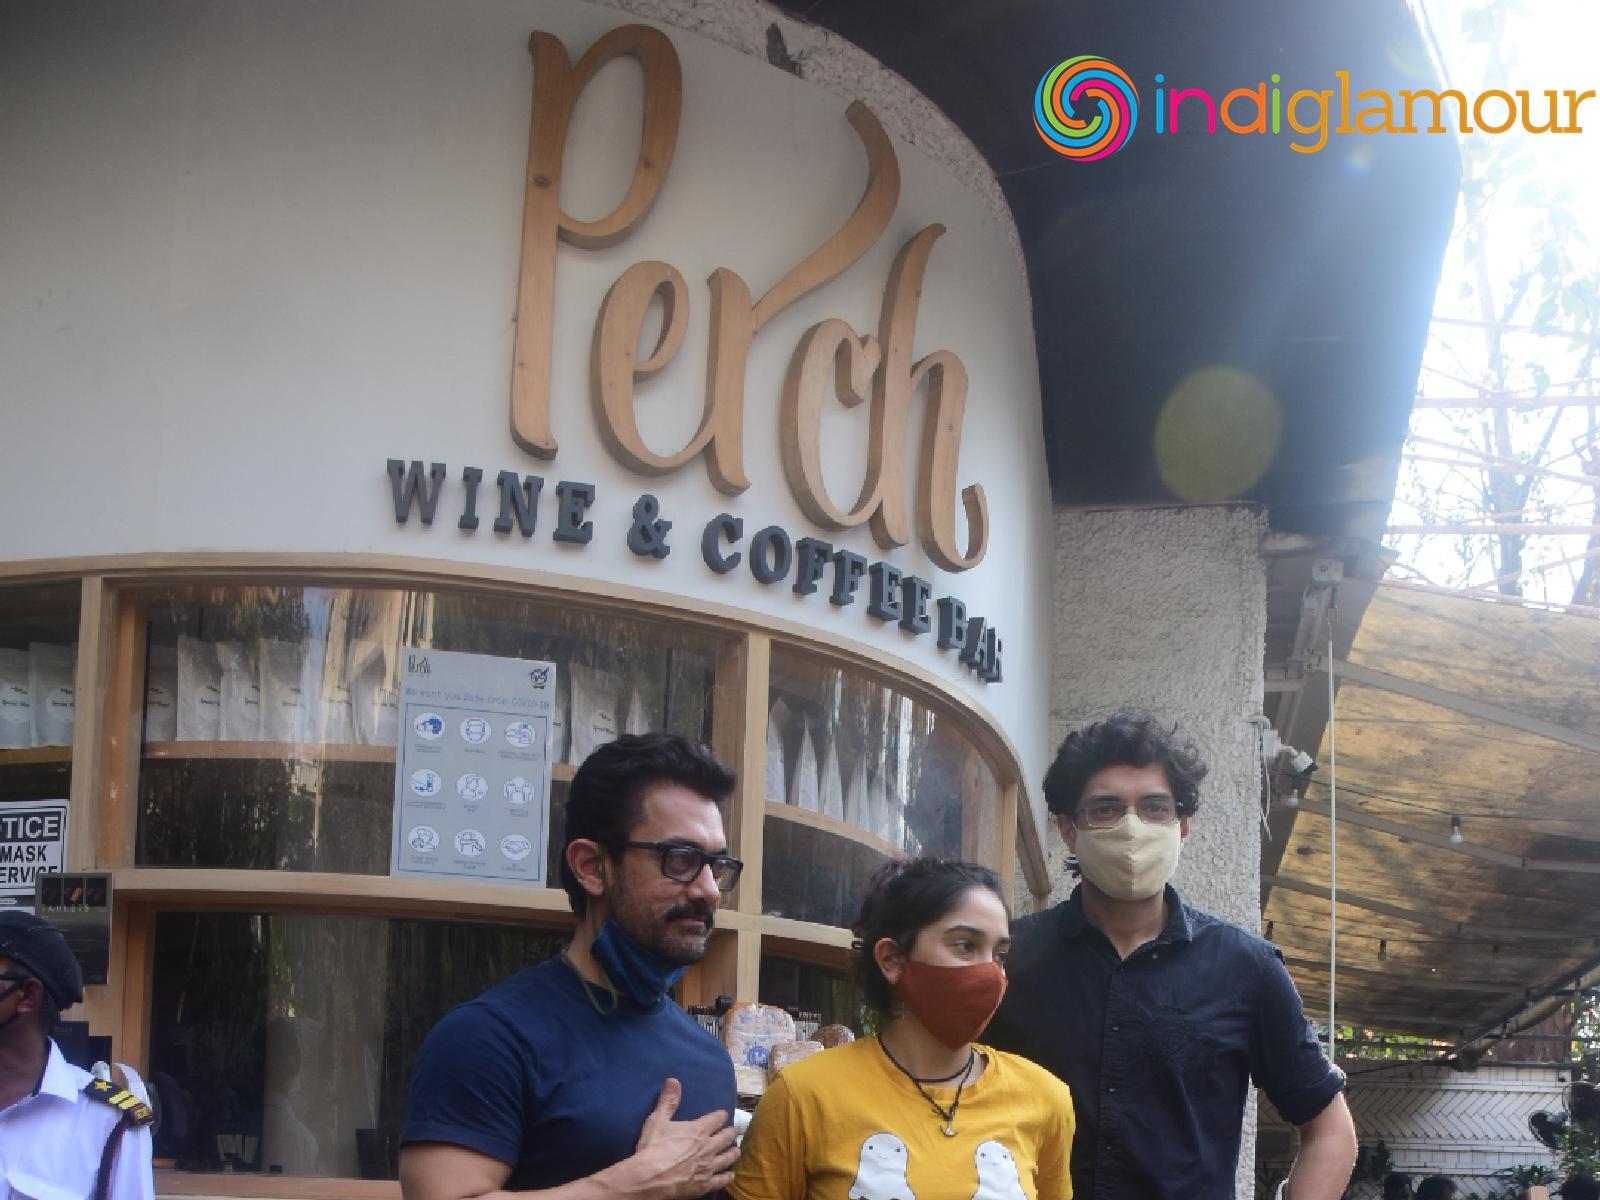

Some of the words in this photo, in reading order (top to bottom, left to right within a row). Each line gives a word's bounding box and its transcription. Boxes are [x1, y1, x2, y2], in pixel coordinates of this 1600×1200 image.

[510, 23, 989, 572] Perch
[387, 457, 596, 544] WINE
[627, 494, 672, 559] &
[701, 512, 933, 636] COFFEE
[0, 816, 59, 839] TICE
[0, 845, 47, 863] MASK
